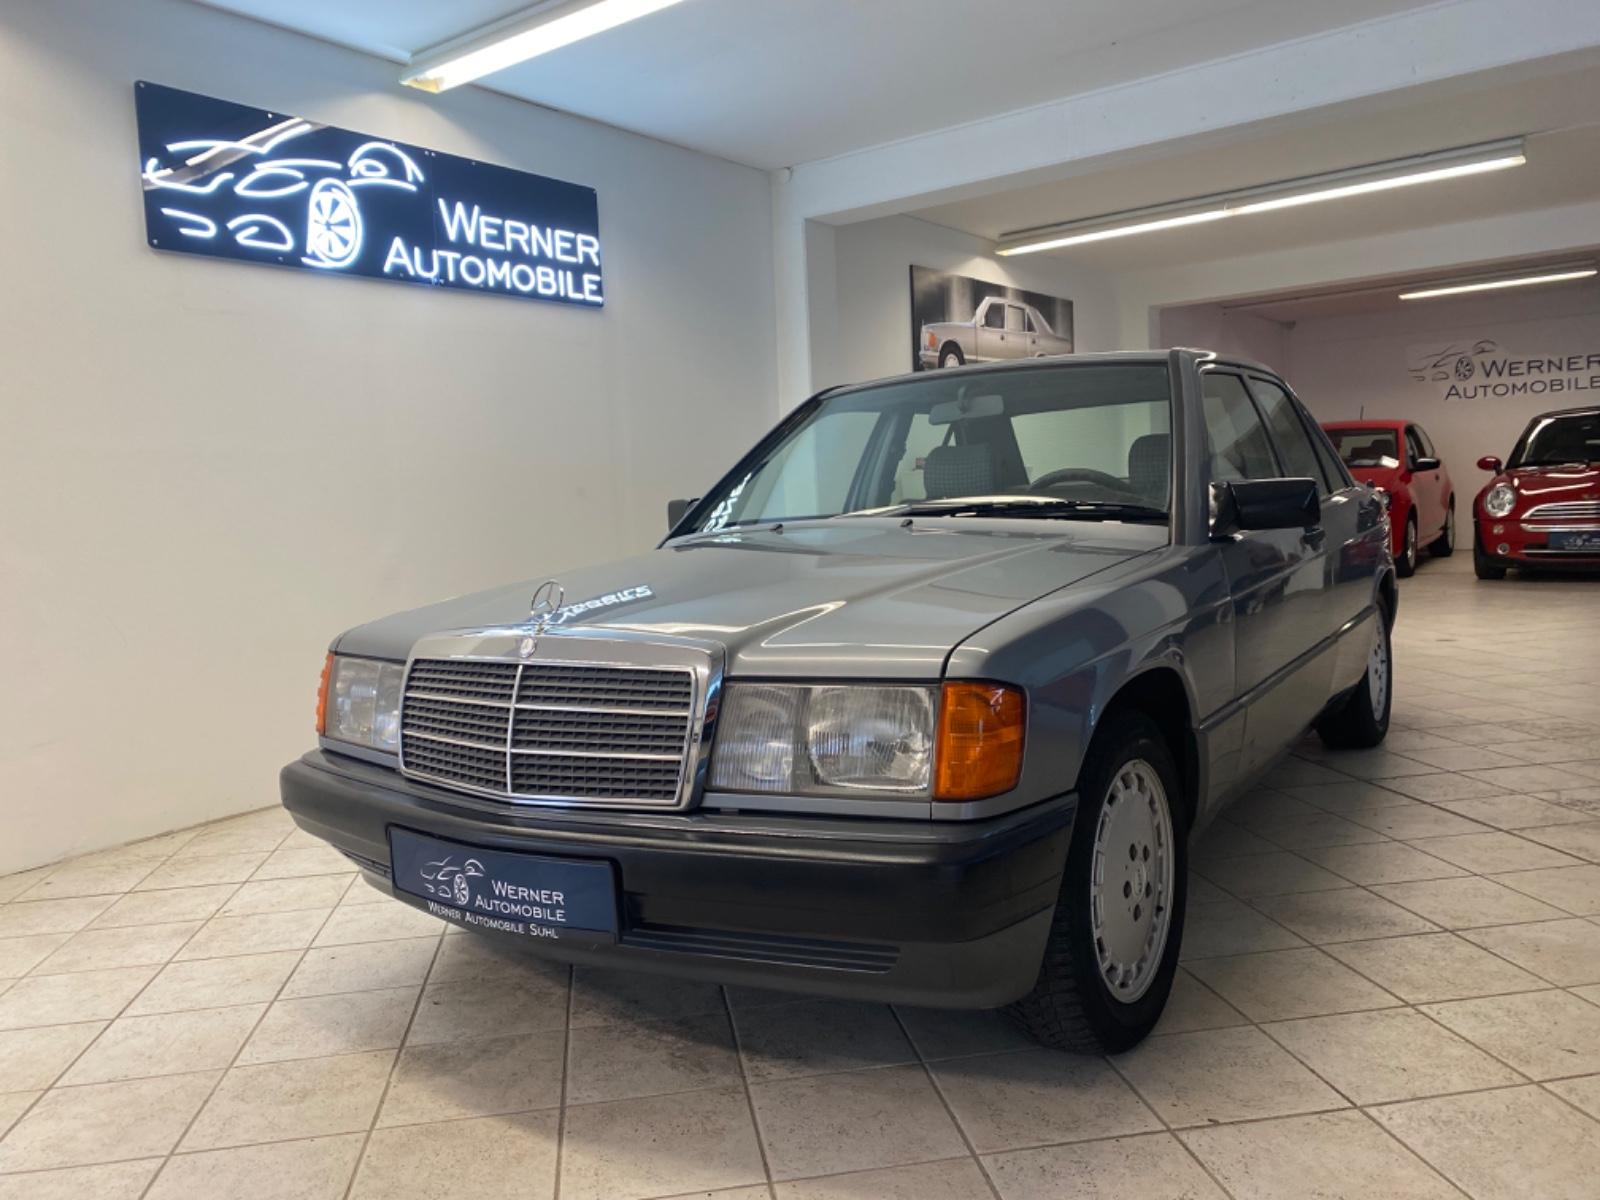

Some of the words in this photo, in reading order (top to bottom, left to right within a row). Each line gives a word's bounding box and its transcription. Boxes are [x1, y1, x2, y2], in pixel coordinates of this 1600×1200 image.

[437, 197, 600, 266] WERNER
[383, 236, 603, 303] AUTOMOBILE
[474, 895, 566, 921] AUTOMOBILE
[491, 879, 565, 906] WERNER
